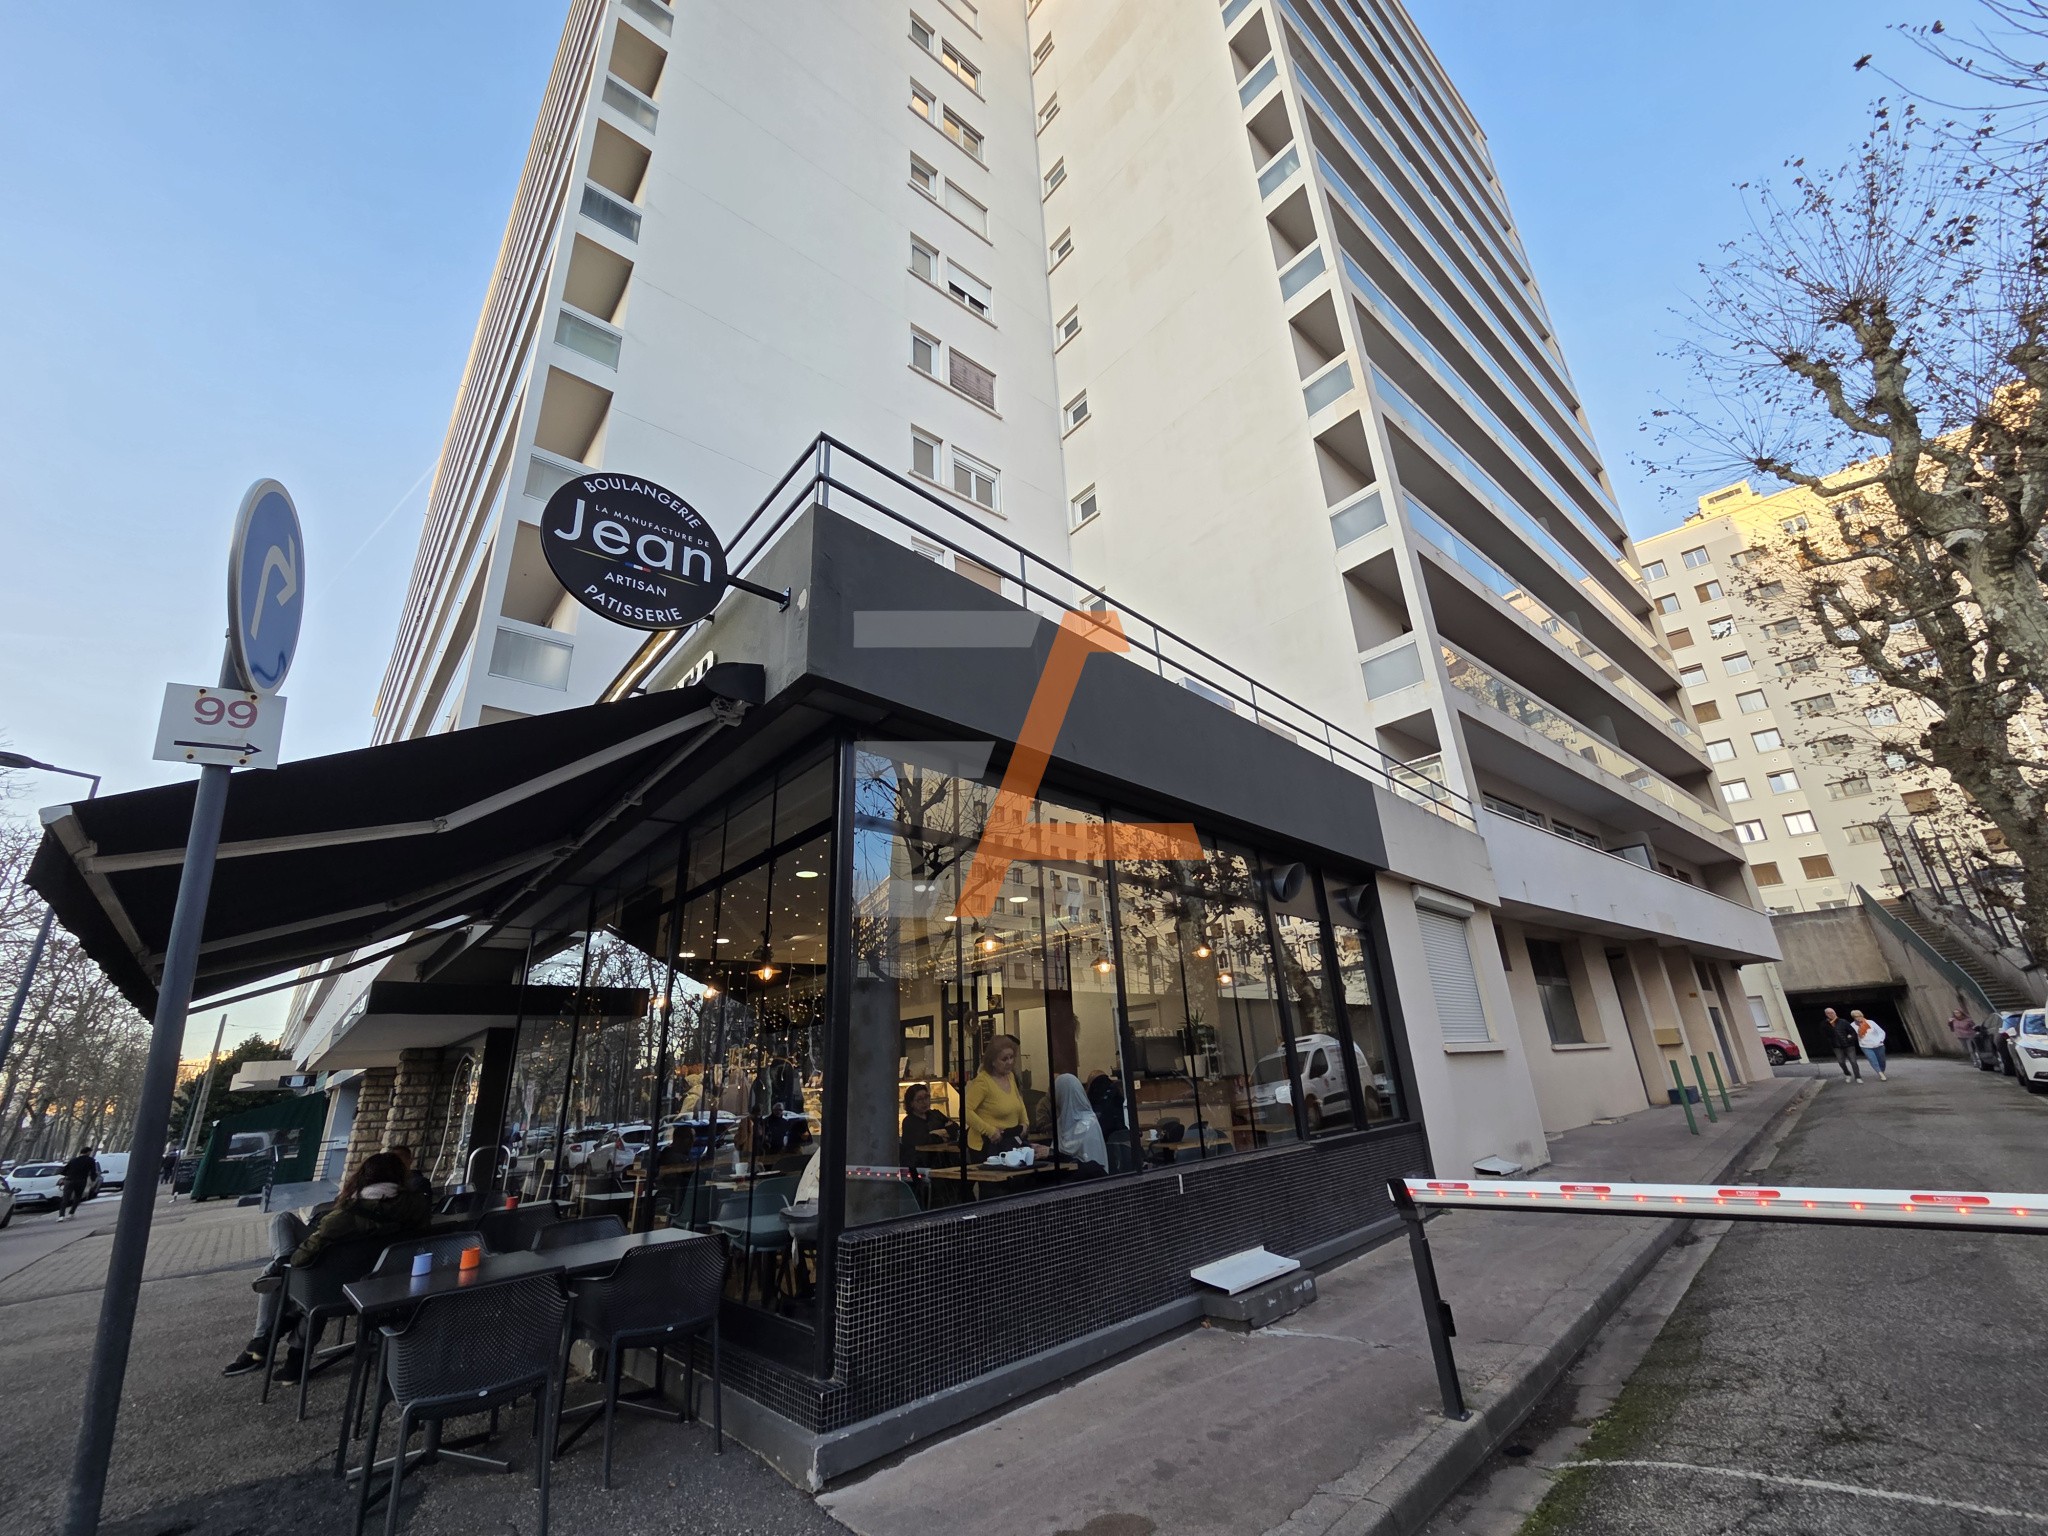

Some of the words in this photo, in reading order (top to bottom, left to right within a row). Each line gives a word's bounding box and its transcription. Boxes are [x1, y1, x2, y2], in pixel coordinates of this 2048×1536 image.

[583, 477, 702, 529] BOULANGERIE
[554, 499, 712, 583] Jean
[595, 504, 609, 514] LA
[613, 511, 693, 542] MANUFACTURE
[697, 538, 710, 548] DE
[584, 584, 682, 622] PATISSERIE
[604, 572, 667, 597] ARTISAN
[194, 697, 258, 729] 99
